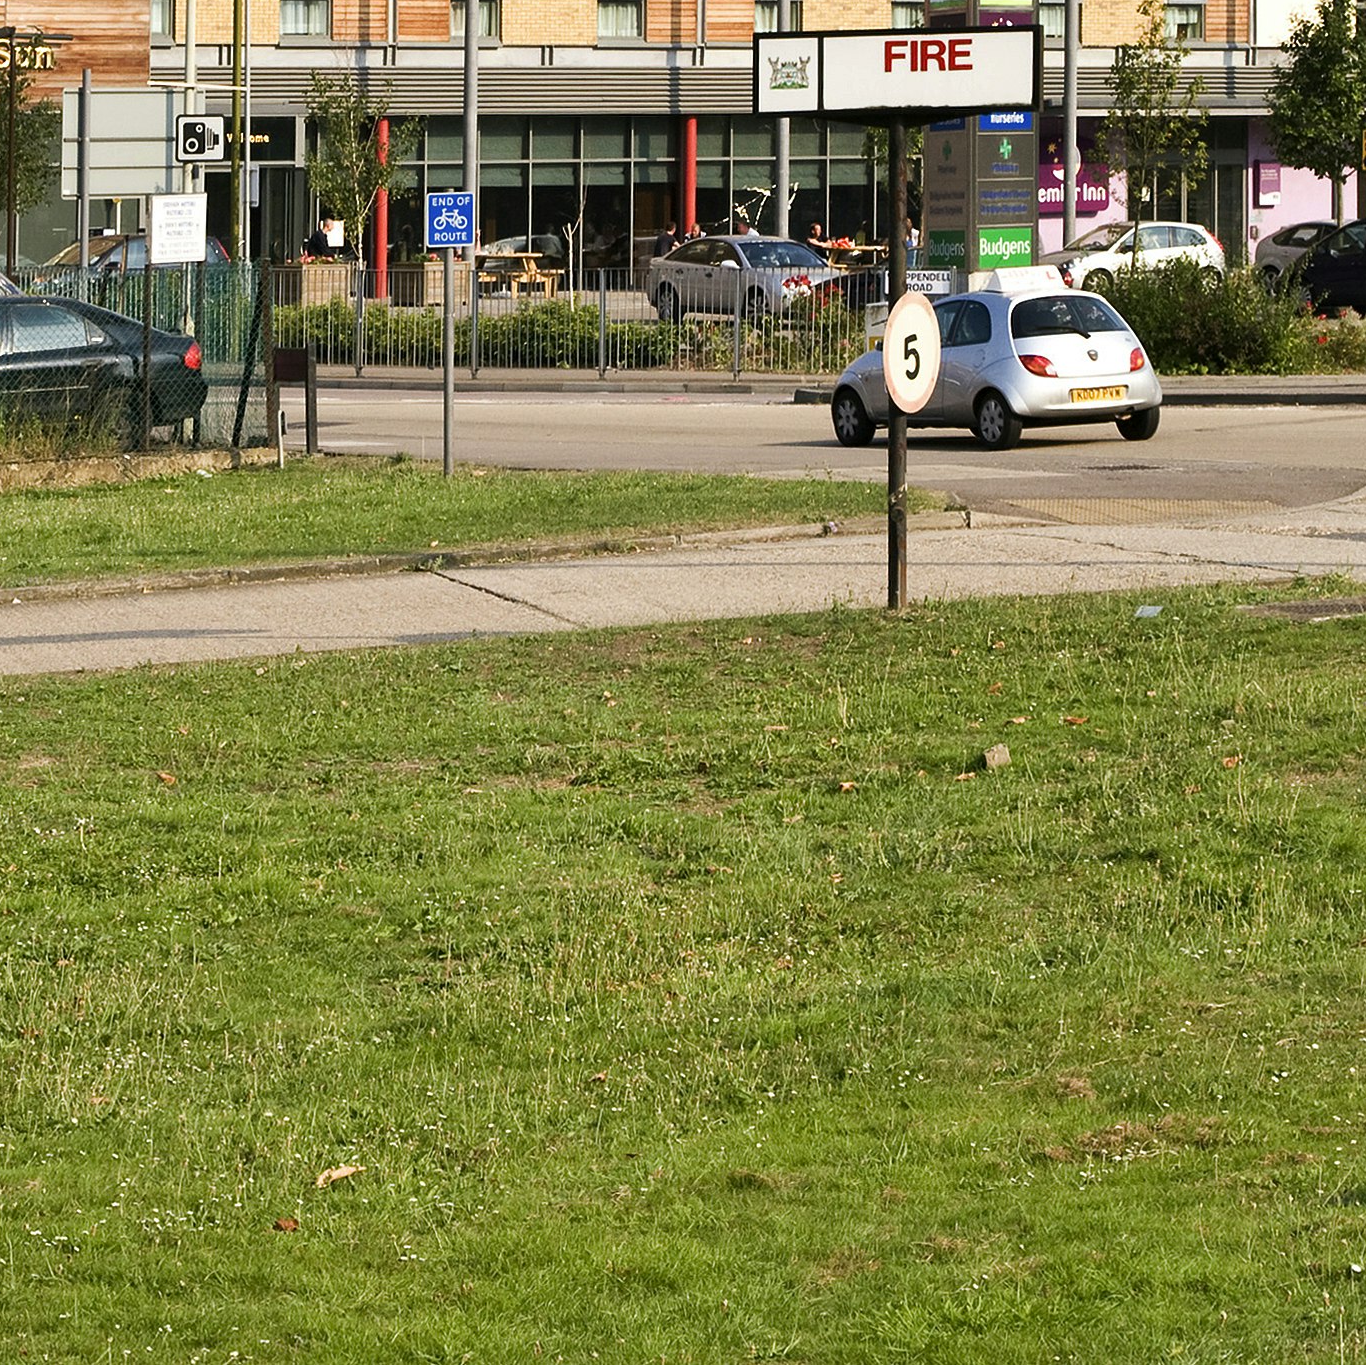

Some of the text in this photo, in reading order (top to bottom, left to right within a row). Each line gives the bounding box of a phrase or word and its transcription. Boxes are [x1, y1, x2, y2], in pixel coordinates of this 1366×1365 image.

[885, 39, 973, 72] FIRE
[432, 196, 470, 206] END OF
[1083, 183, 1106, 201] Inn
[434, 232, 467, 241] ROUTE
[929, 239, 965, 260] Budgens
[980, 237, 1031, 260] Budgens
[906, 273, 952, 282] PPENDELL
[907, 283, 933, 292] ROAD
[904, 334, 920, 380] 5
